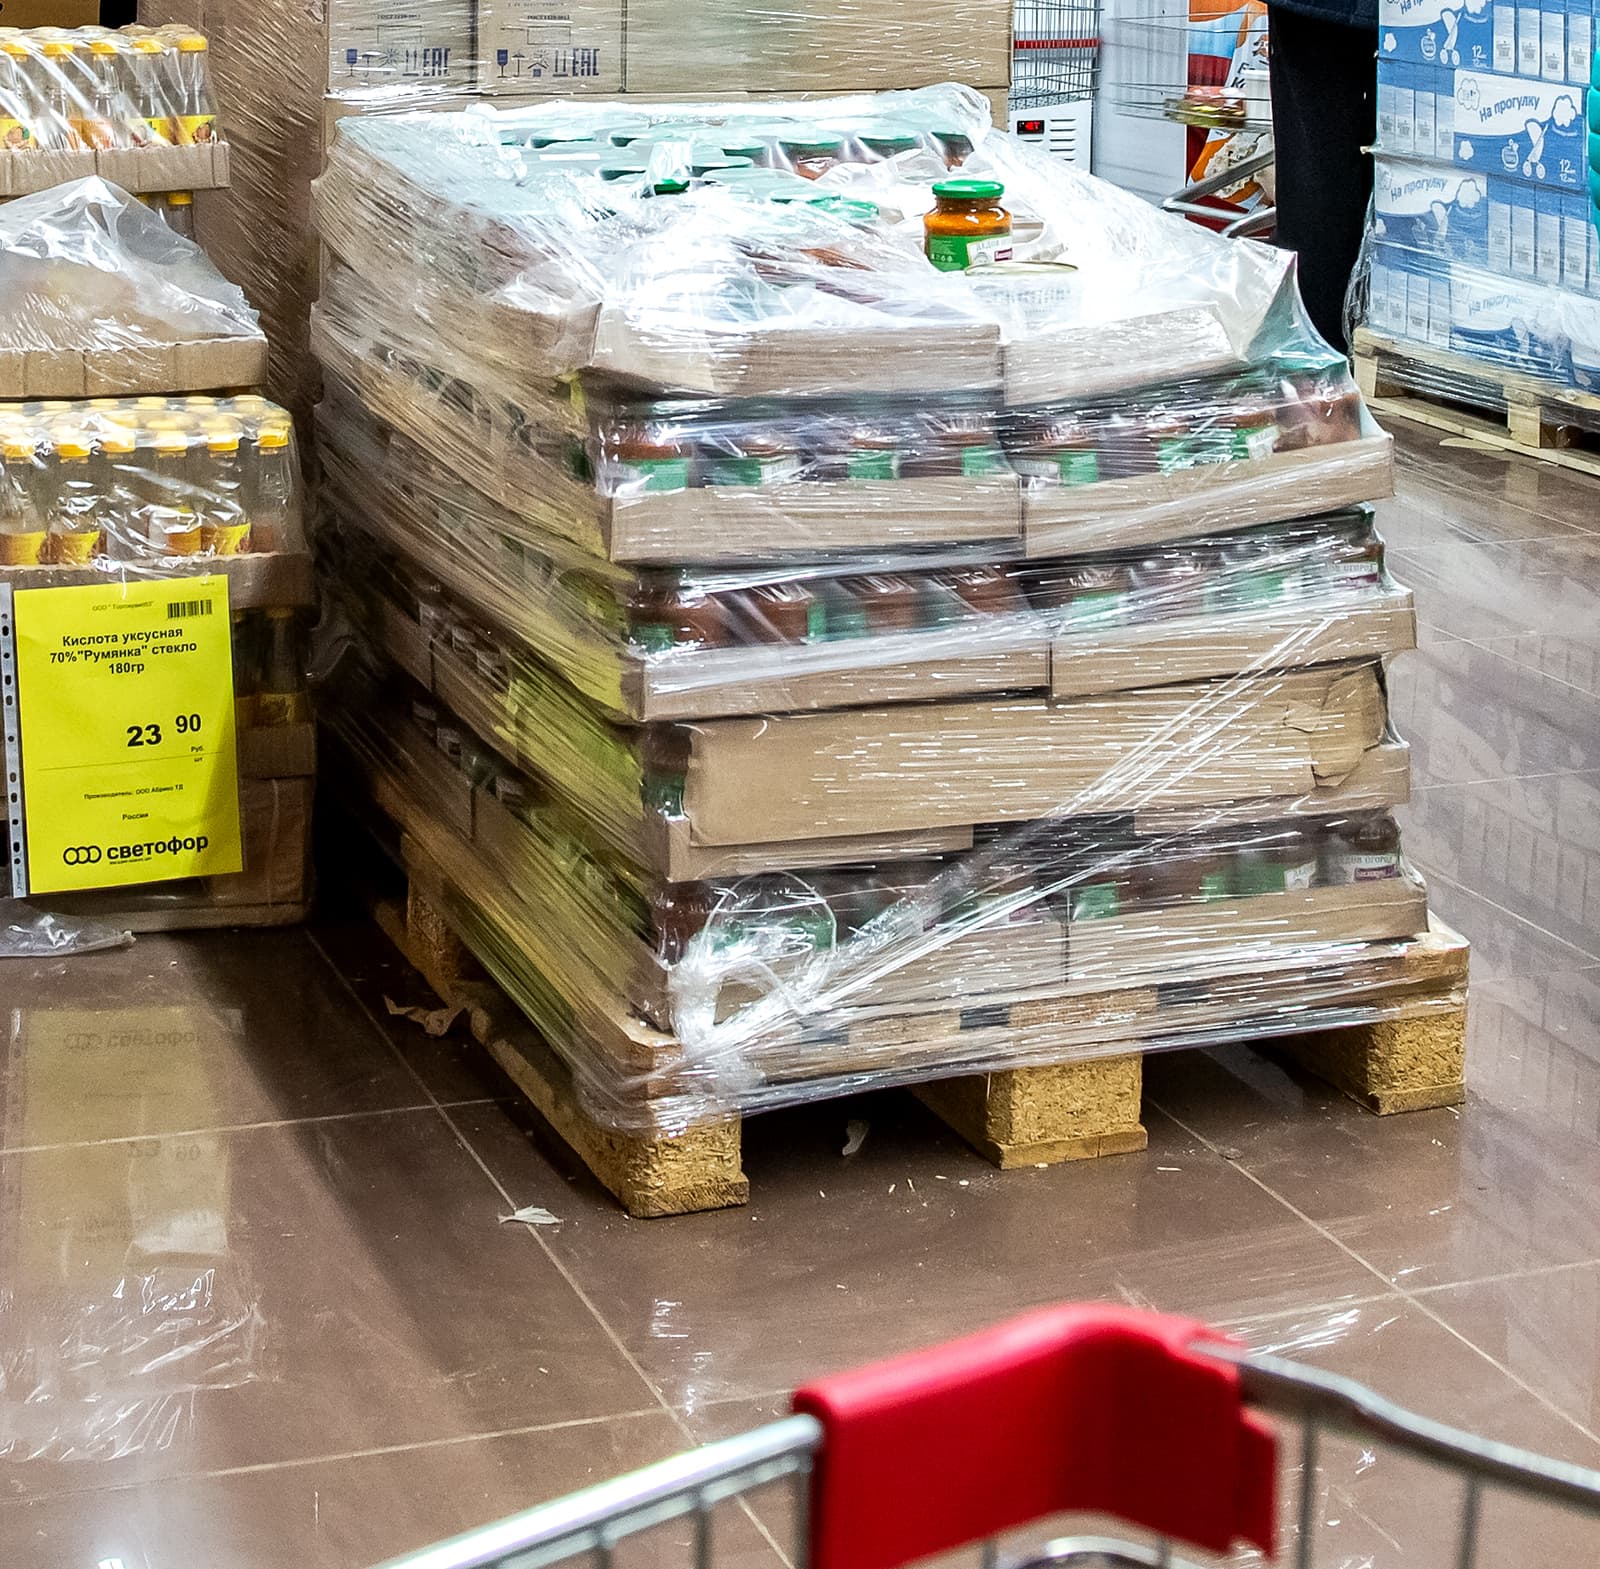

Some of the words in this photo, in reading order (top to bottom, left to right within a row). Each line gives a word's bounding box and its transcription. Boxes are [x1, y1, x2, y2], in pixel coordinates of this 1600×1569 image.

[1471, 44, 1483, 58] 12
[572, 48, 600, 76] EAC
[1479, 102, 1491, 122] На
[1493, 94, 1540, 117] прогулку
[1559, 159, 1571, 172] 12
[1391, 182, 1402, 201] На
[1404, 176, 1448, 197] прогулку
[62, 632, 118, 647] Кислота
[122, 627, 183, 645] уксусная
[50, 645, 148, 665] 70%"Румянка"
[151, 642, 197, 654] стекло
[108, 662, 145, 676] 180гр
[126, 725, 162, 748] 23
[175, 713, 201, 733] 90
[136, 787, 150, 795] ООО
[122, 812, 149, 821] Россия
[107, 835, 209, 859] светофор
